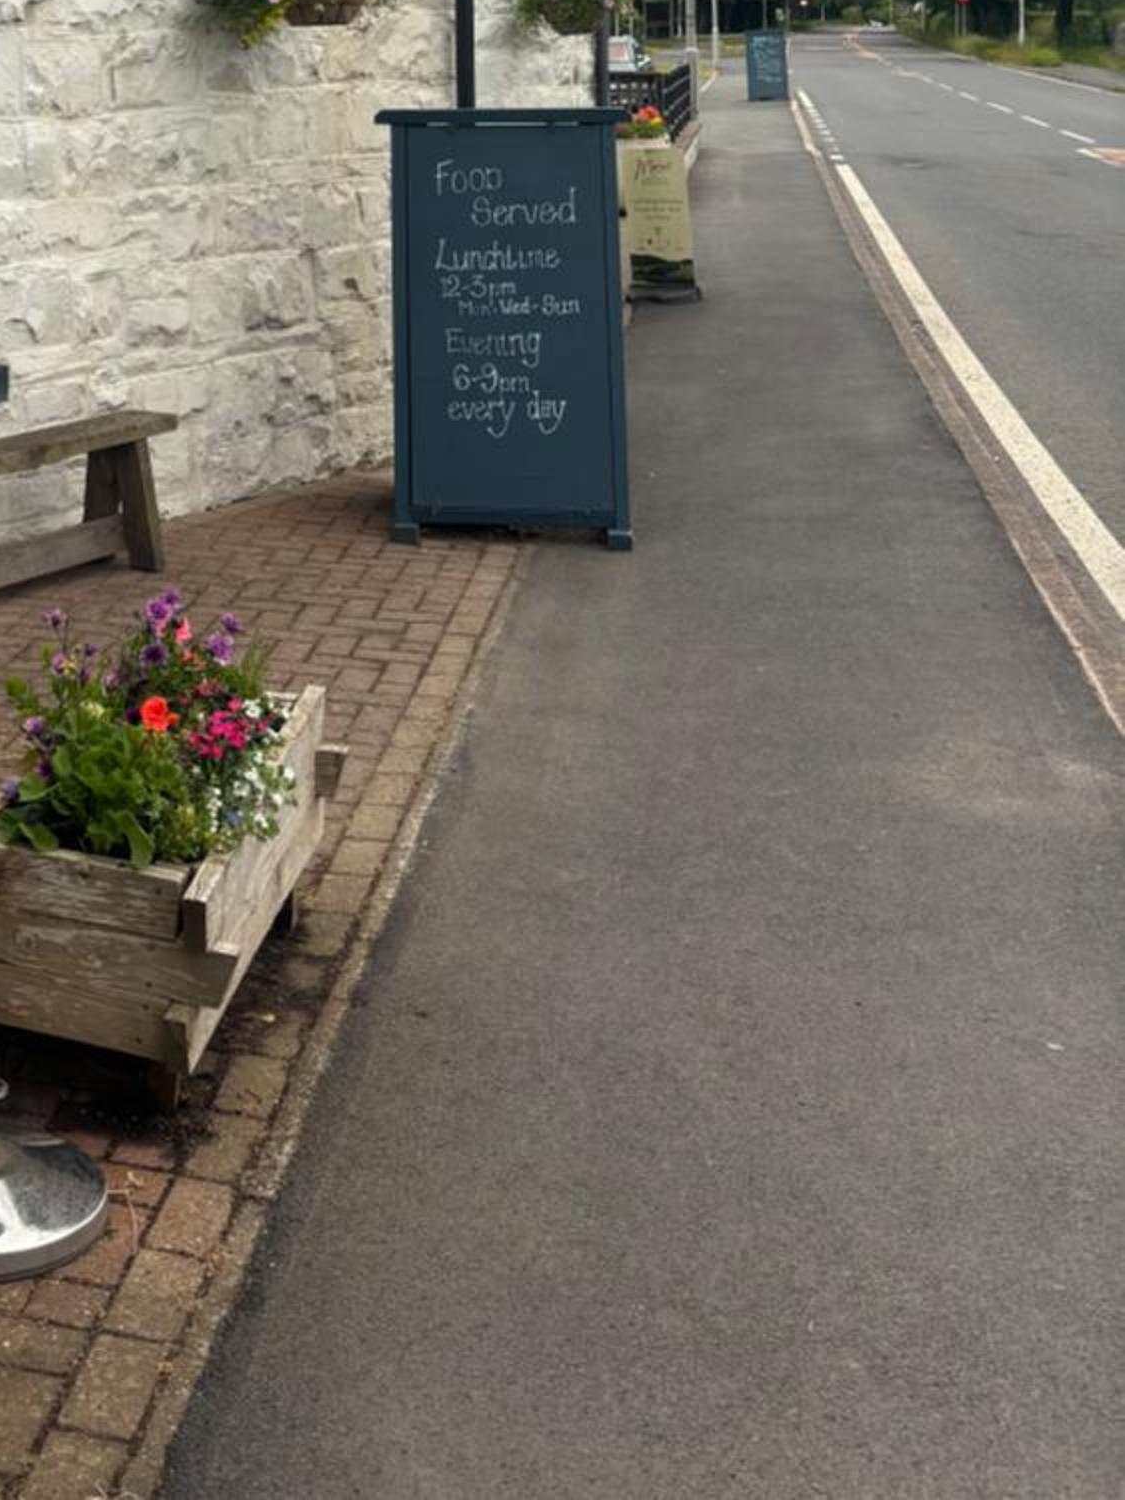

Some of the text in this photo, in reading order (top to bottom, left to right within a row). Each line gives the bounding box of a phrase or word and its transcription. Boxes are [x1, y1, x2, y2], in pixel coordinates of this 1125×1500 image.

[470, 185, 577, 227] Served
[434, 237, 562, 271] Lunchtime
[444, 327, 542, 369] Evening
[452, 362, 530, 402] 6-9pm
[447, 389, 567, 439] every day
